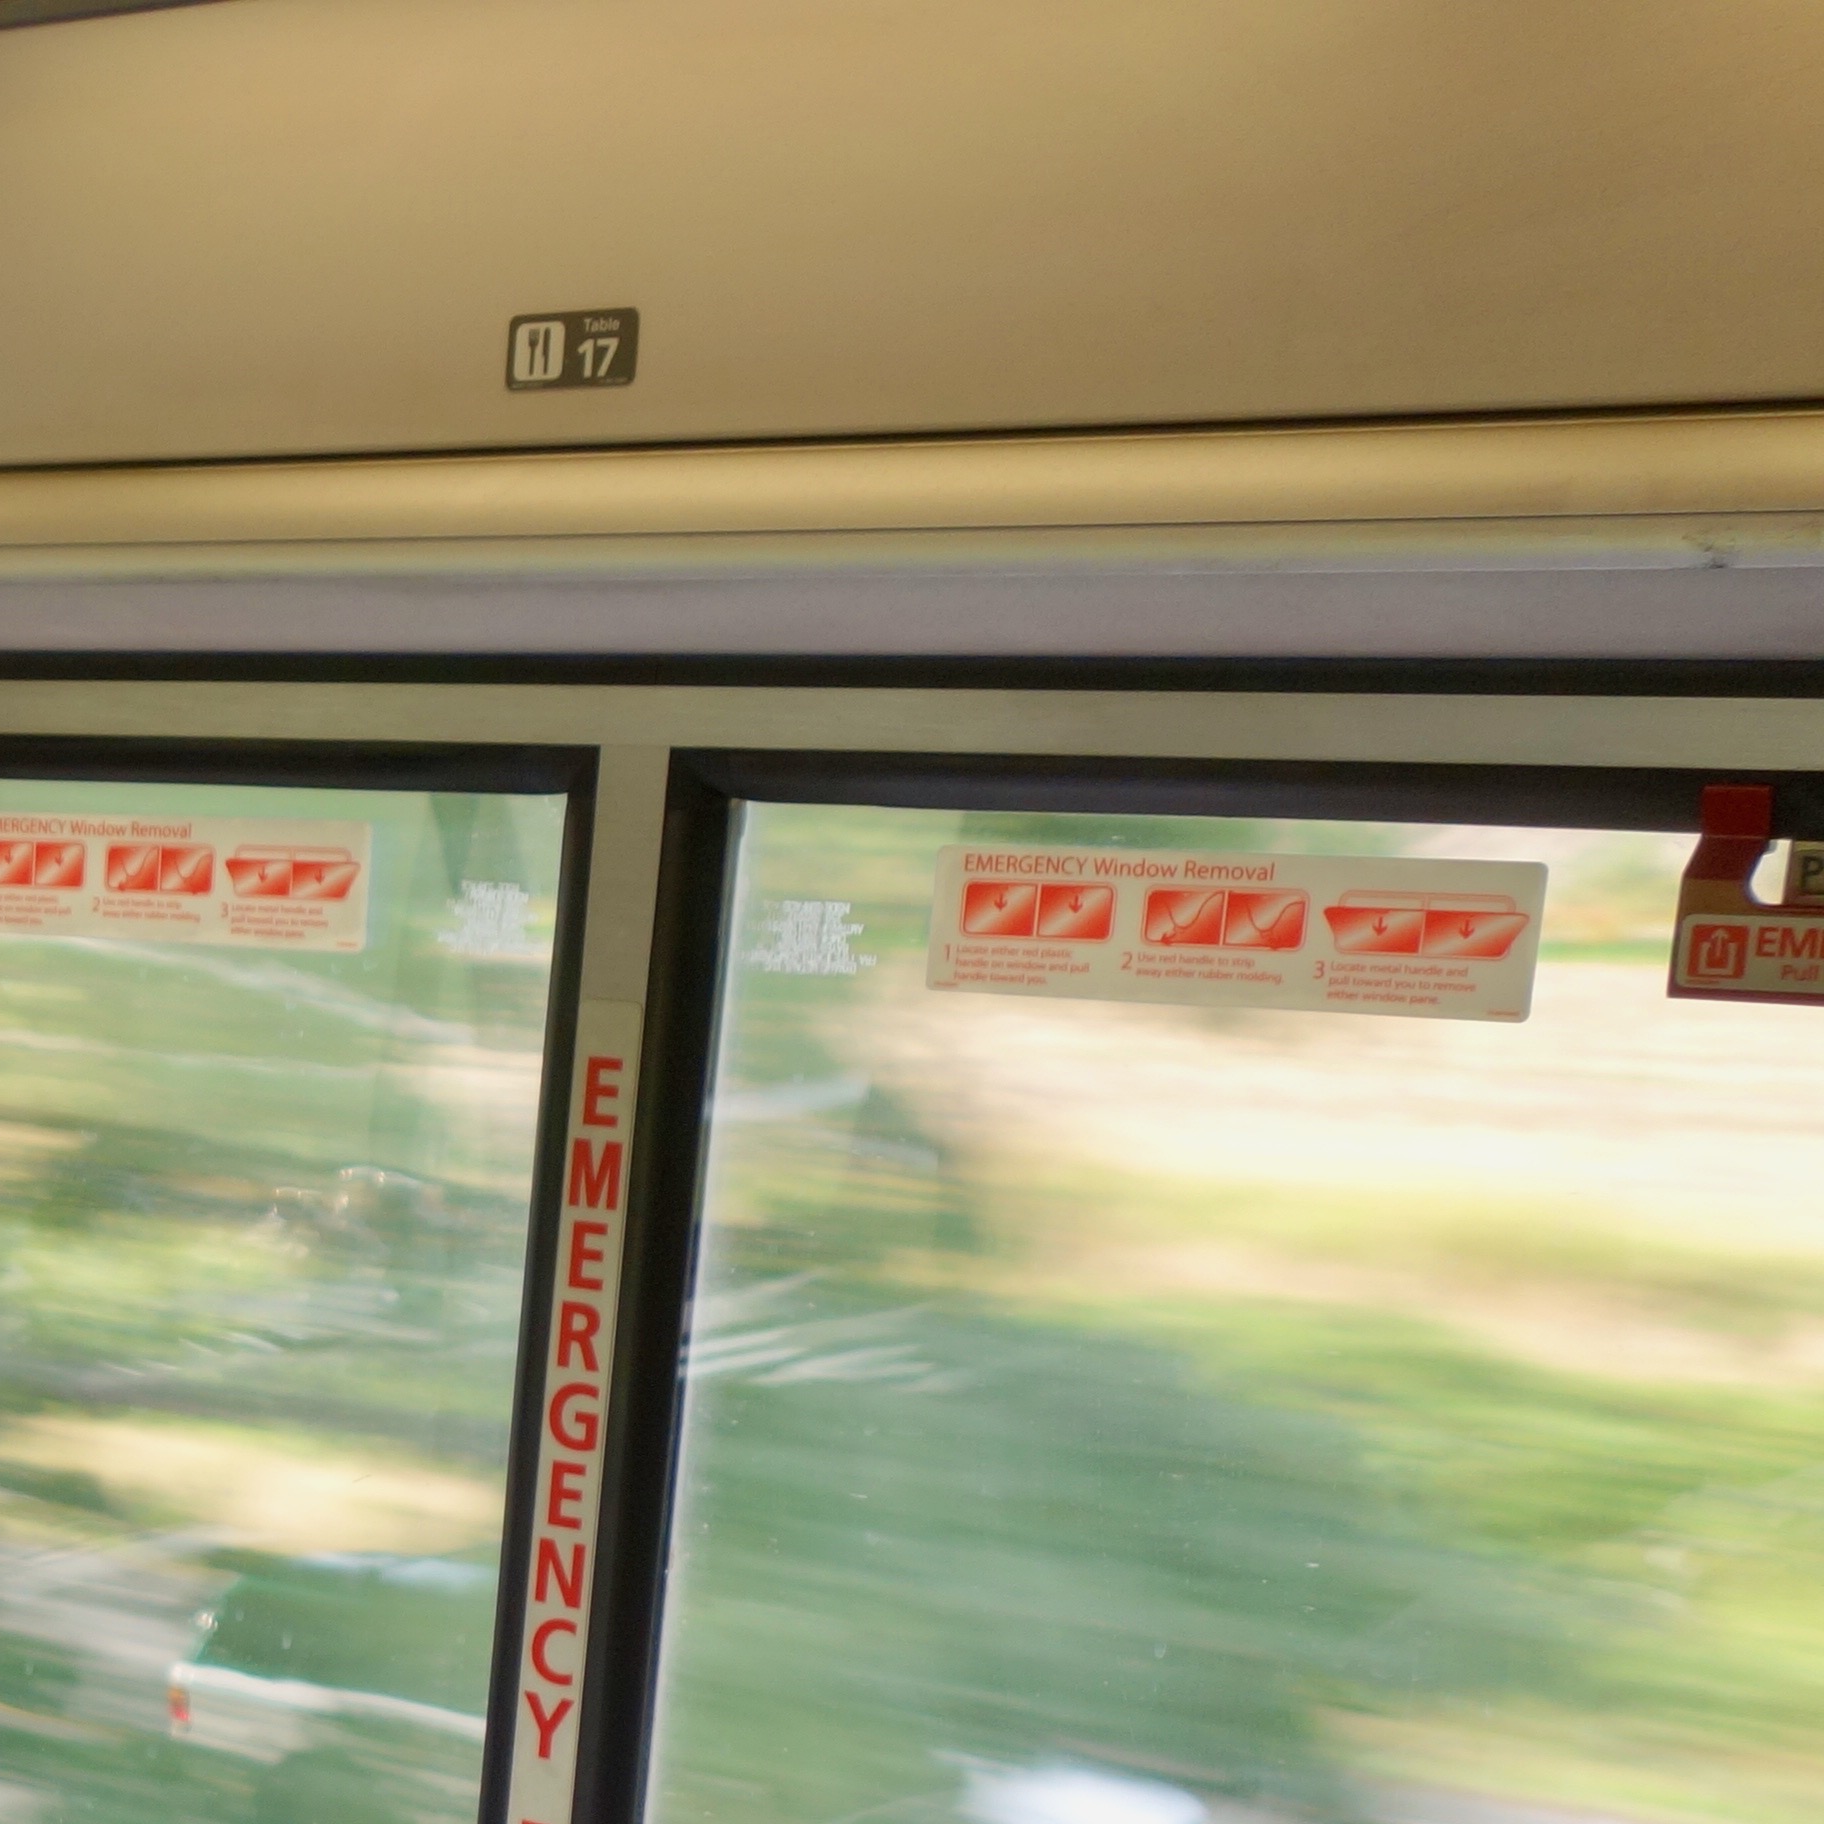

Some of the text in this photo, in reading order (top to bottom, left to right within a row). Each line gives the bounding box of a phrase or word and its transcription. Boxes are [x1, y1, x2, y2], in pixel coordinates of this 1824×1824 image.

[584, 318, 620, 331] Table
[577, 338, 620, 378] 17
[70, 820, 128, 837] Window
[131, 822, 192, 838] Removal
[964, 854, 1275, 881] EMERGENCY Window Removal
[93, 898, 101, 911] 2
[221, 904, 229, 917] 3
[944, 944, 1073, 961] 1 Locate either red plastic
[1121, 952, 1256, 969] 2 Use red handle to strip
[955, 958, 1090, 974] handle on window and pull
[1136, 967, 1163, 978] away
[1164, 967, 1194, 978] either
[1198, 968, 1234, 980] rubber
[1314, 961, 1468, 979] 3 Locate metal handle and
[1782, 965, 1818, 981] Pull
[954, 971, 988, 982] handle
[990, 972, 1024, 984] toward
[1328, 976, 1476, 992] pull toward you to remove
[1327, 989, 1358, 1001] either
[1362, 990, 1406, 1004] window
[523, 1058, 623, 1760] EMERGENCY
